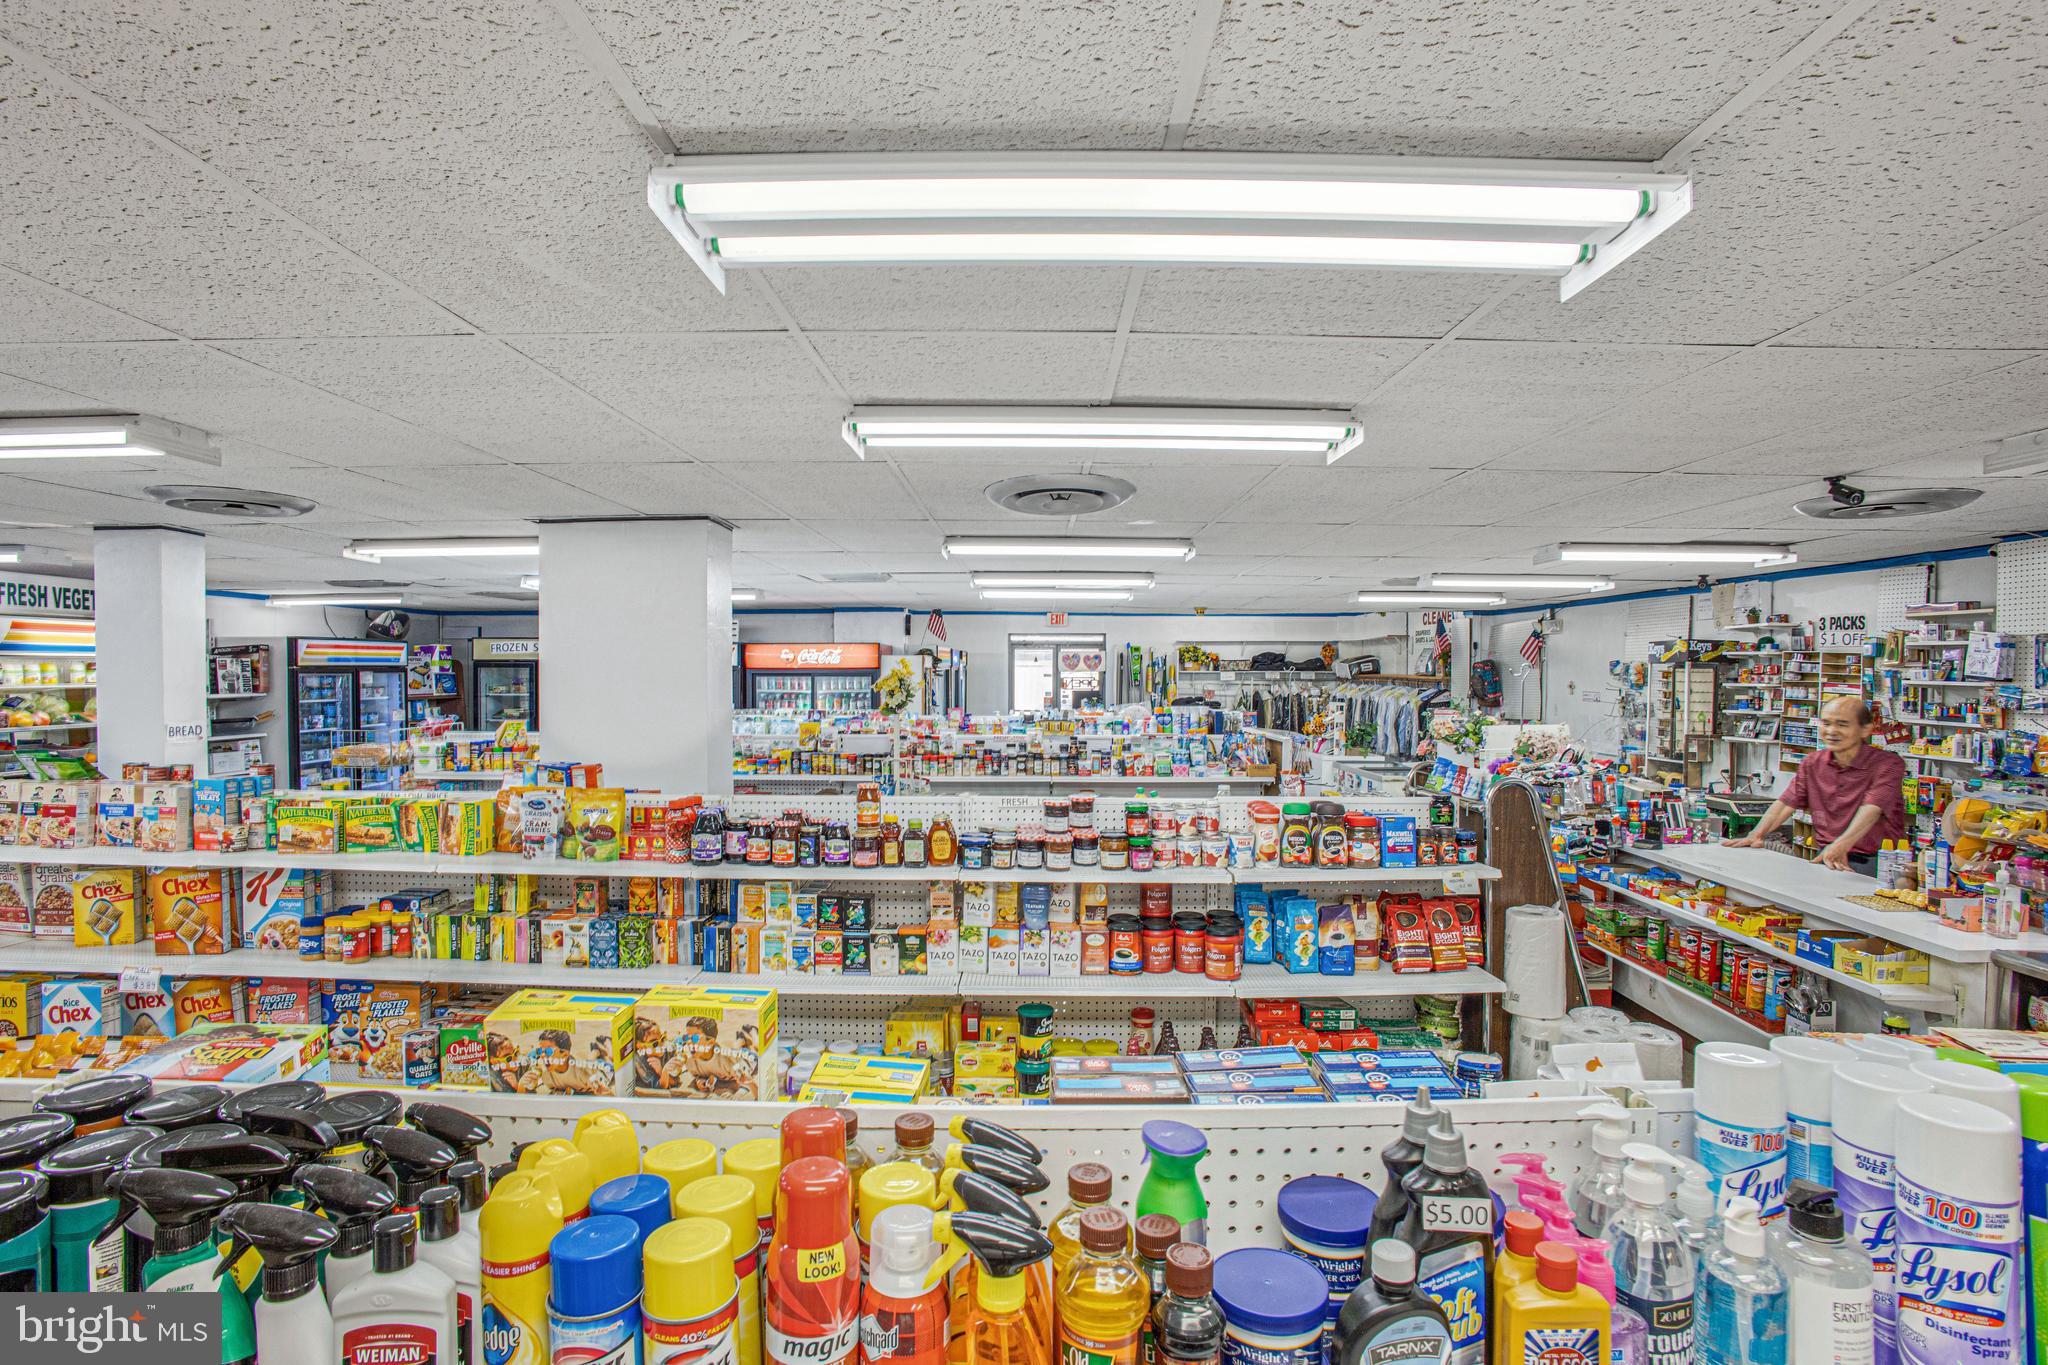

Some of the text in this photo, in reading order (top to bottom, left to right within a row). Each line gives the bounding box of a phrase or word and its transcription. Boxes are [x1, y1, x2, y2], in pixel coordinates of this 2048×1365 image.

[0, 582, 95, 611] FRESH VEGET
[1050, 613, 1065, 625] EXIT
[1819, 615, 1866, 631] 3 PACKS
[1843, 632, 1866, 645] OFF
[490, 642, 529, 653] FROZEN
[1648, 643, 1665, 657] Keys
[1689, 639, 1713, 652] Keys
[168, 723, 204, 738] BREAD
[1001, 798, 1029, 807] FRESH
[280, 808, 332, 819] NATURE VALLEY
[35, 865, 64, 878] great
[40, 874, 73, 886] grains
[96, 879, 118, 887] Wheat
[162, 877, 212, 896] Chex
[82, 884, 124, 900] Chex
[246, 867, 285, 907] K
[1147, 890, 1167, 898] Folgers
[278, 900, 302, 909] Original
[965, 901, 991, 912] TAZO
[1050, 899, 1071, 908] AZO
[1397, 929, 1424, 938] EIGHT
[1434, 932, 1460, 941] EIGHT
[929, 951, 955, 960] TAZO
[961, 948, 985, 958] TAZO
[1151, 945, 1171, 953] Folgers
[1181, 945, 1202, 953] Folgers
[991, 951, 1017, 961] TAZO
[1022, 952, 1048, 961] TAZO
[1053, 953, 1079, 962] TAZO
[63, 998, 80, 1007] Rice
[125, 992, 167, 1010] Chex
[259, 993, 297, 1003] FROSTED
[370, 999, 409, 1010] FROSTED
[180, 996, 223, 1014] Chex
[262, 1001, 294, 1011] FLAKES
[1817, 1002, 1831, 1013] 20
[49, 1005, 93, 1024] Chex
[373, 1008, 405, 1018] FLAKES
[672, 1007, 722, 1020] NATURE VALLEY
[522, 1020, 574, 1030] NATURE VALLEY
[450, 1043, 483, 1054] Orville
[676, 1043, 711, 1053] better
[409, 1063, 438, 1074] QUAKER
[414, 1070, 433, 1078] OATS
[1719, 1128, 1749, 1142] KILLS
[1721, 1136, 1748, 1149] OVER
[1752, 1132, 1783, 1152] 100
[1855, 1153, 1888, 1170] KILLS
[1856, 1160, 1888, 1176] OVER
[1898, 1182, 1921, 1200] KILLS
[1898, 1189, 1920, 1208] OVER
[1425, 1202, 1489, 1227] $5.00
[1922, 1194, 1982, 1230] 100
[1936, 1221, 1949, 1231] THE
[808, 1248, 835, 1265] NEW
[487, 1265, 510, 1276] EASIER
[804, 1263, 841, 1279] LOOK!
[1319, 1259, 1361, 1273] Wright's
[1431, 1281, 1450, 1291] Gentle
[1458, 1270, 1478, 1281] surfaces
[1900, 1247, 2006, 1302] Lysol
[166, 1283, 194, 1293] QUARTZ
[1833, 1301, 1862, 1313] FIRST
[1918, 1302, 1954, 1318] 99.9%
[655, 1318, 731, 1344] CLEANS 40% FASTER
[1925, 1317, 2012, 1348] Disinfectant
[783, 1328, 851, 1362] magic
[356, 1346, 421, 1364] WEIMAN
[1240, 1344, 1290, 1364] Wright's
[1971, 1345, 2011, 1361] Spray
